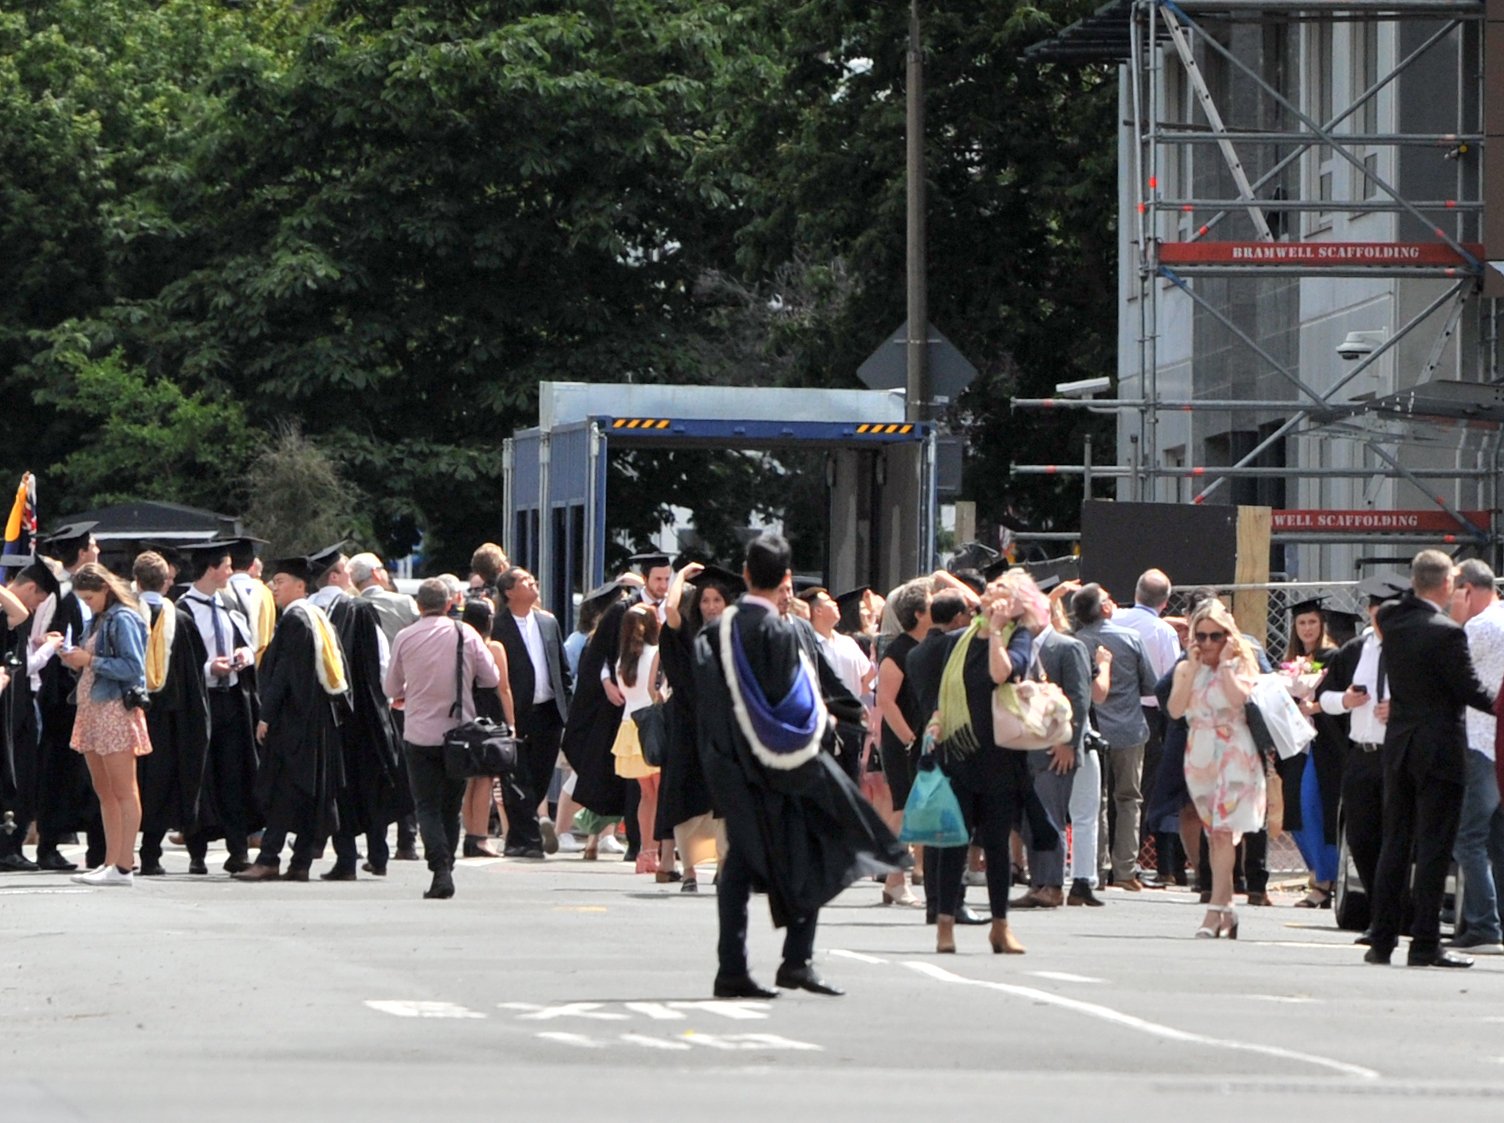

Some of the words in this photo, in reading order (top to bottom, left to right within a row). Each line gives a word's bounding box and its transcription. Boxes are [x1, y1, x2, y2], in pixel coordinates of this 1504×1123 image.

[1232, 247, 1314, 258] BRAMWELL
[1318, 246, 1419, 258] SCAFFOLDING
[1271, 514, 1313, 526] WELL
[1317, 514, 1418, 527] SCAFFOLDING
